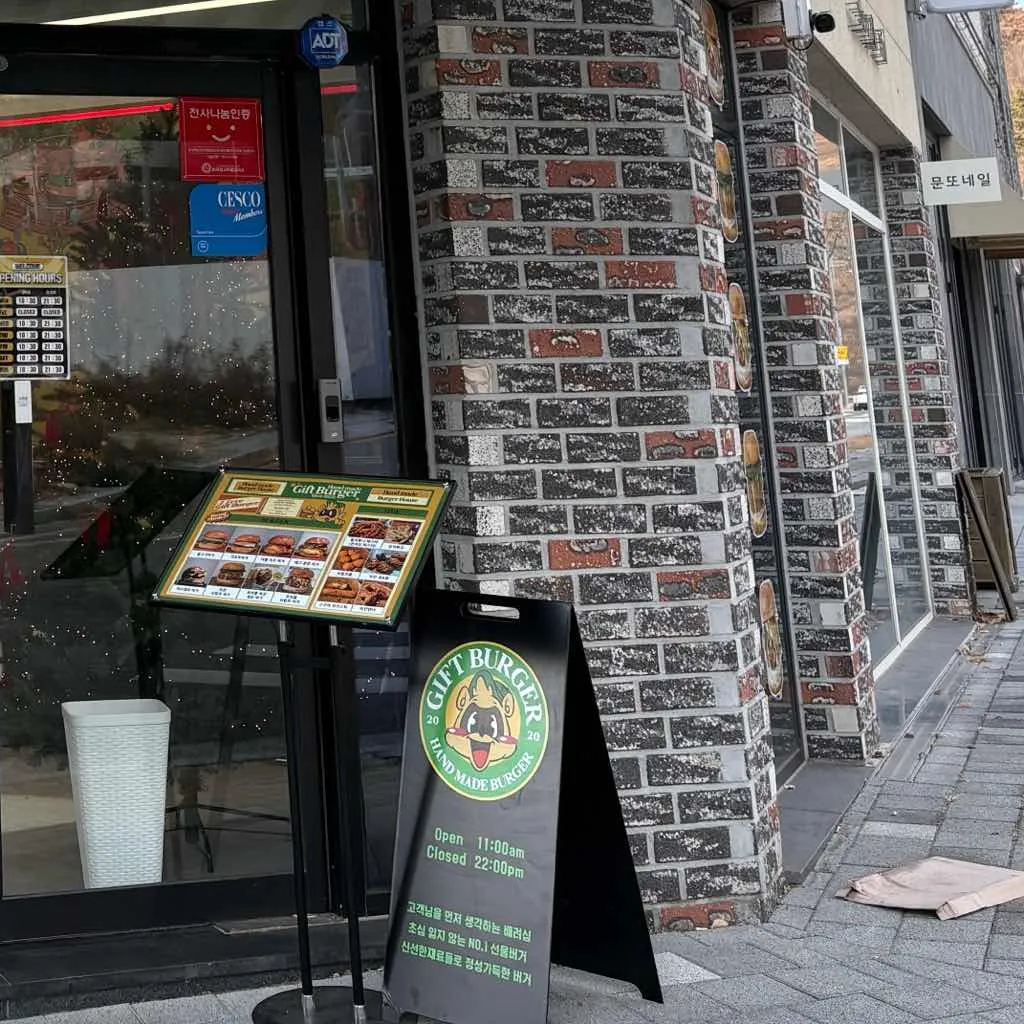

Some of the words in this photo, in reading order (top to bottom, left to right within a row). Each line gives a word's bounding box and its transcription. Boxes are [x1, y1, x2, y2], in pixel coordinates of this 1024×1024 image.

[311, 32, 341, 49] ADT
[930, 172, 992, 190] 문또네일
[217, 191, 261, 208] CESCO
[33, 272, 63, 283] HOURS
[292, 484, 315, 495] Gift
[315, 486, 361, 498] Burger
[427, 653, 465, 711] GIFT
[469, 647, 543, 726] BURGER
[426, 715, 439, 726] 20
[527, 731, 540, 742] 20
[430, 737, 456, 776] HAND
[454, 770, 488, 792] MADE
[490, 752, 534, 792] BURGER
[434, 827, 464, 846] Open
[477, 836, 525, 859] 11:00am
[426, 845, 467, 866] Closed
[474, 855, 524, 879] 22:00pm
[407, 900, 442, 920] 고객님을
[444, 910, 462, 925] 먼저
[465, 916, 501, 935] 생각하는
[503, 925, 532, 943] 배려심
[408, 921, 426, 936] 초심
[448, 931, 466, 947] 않는
[490, 943, 528, 964] 선물버거
[401, 940, 463, 967] 신선한재료들로
[465, 957, 511, 980] 정성가득한
[513, 970, 532, 987] 버거
